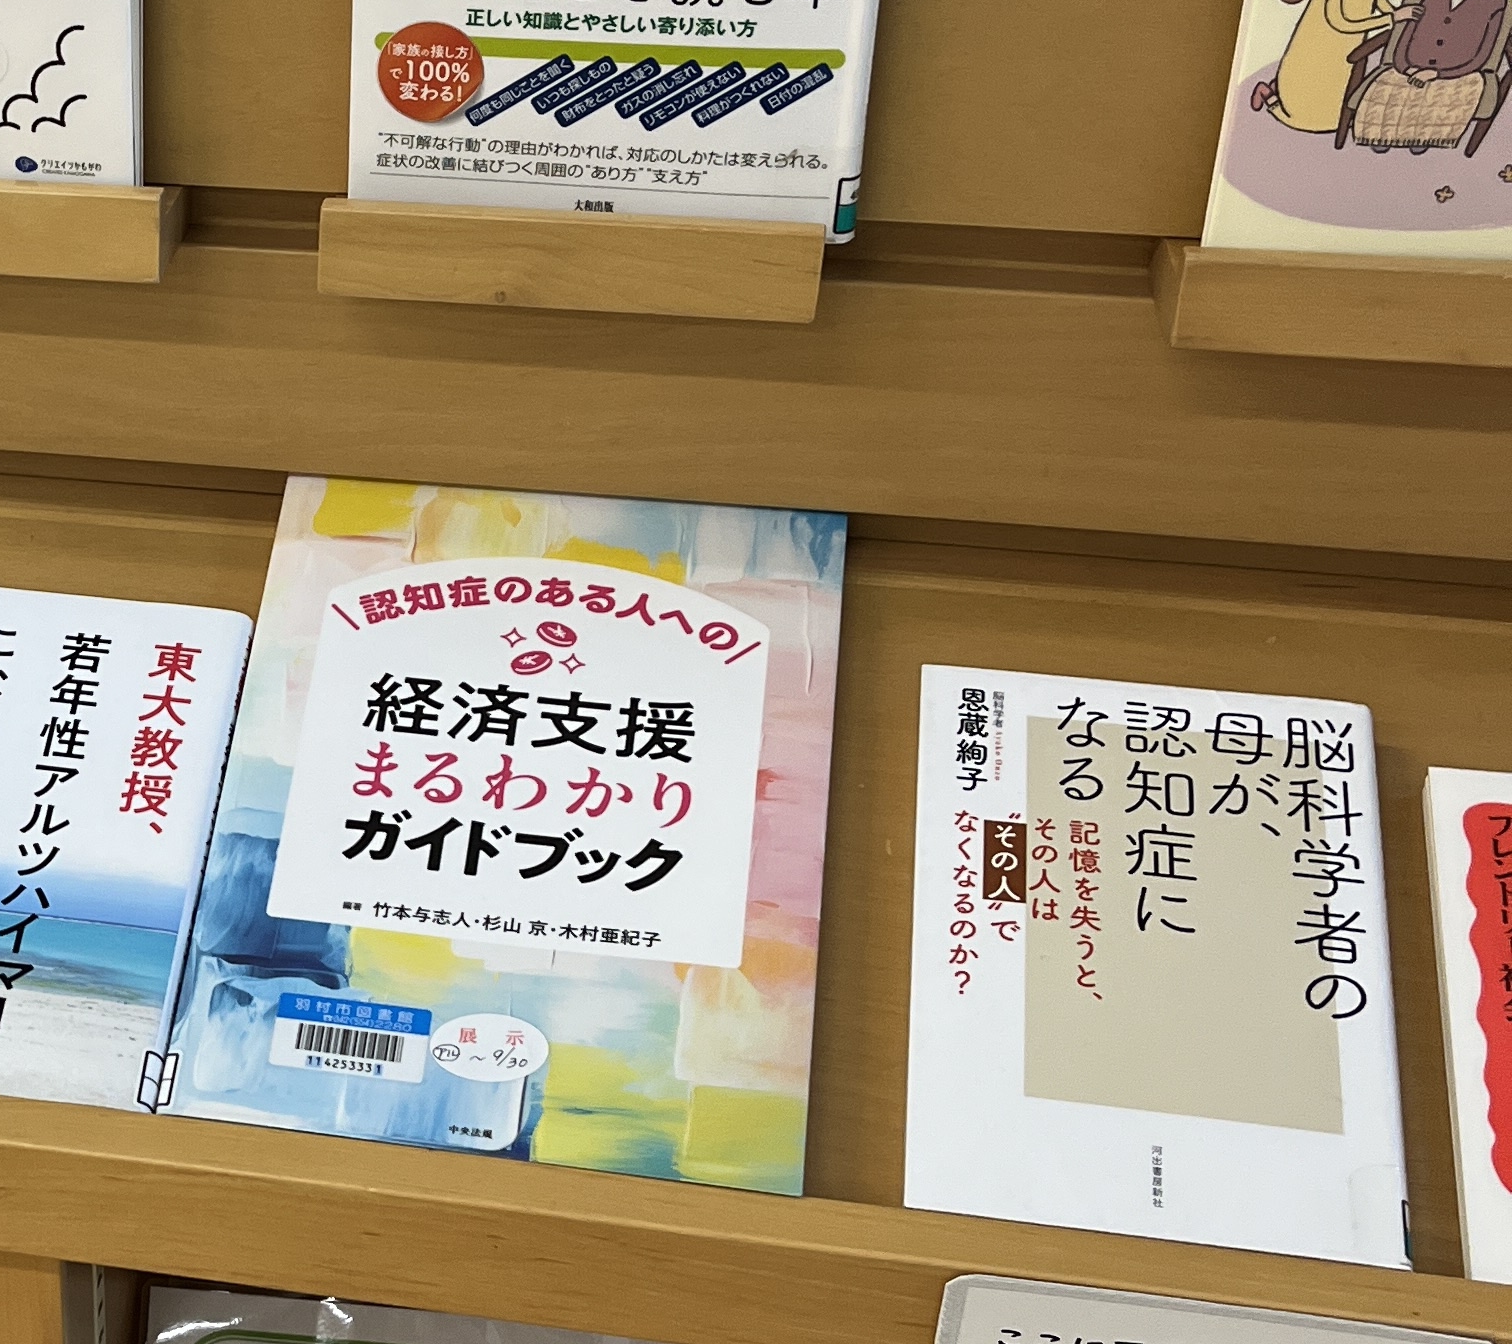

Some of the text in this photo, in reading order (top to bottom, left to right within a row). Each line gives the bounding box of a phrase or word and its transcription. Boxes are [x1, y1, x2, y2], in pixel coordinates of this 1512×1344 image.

[465, 8, 758, 38] 正しい知識とやさしい寄り添い方
[358, 574, 739, 653] 認知症のある人への
[362, 673, 696, 764] 経済支援
[1057, 696, 1110, 802] なる
[351, 741, 692, 830] まるわかり
[1123, 701, 1198, 934] 認知症に
[1205, 712, 1283, 837] 母が、
[341, 807, 685, 893] ガイドブック
[1029, 818, 1060, 923] その人は
[1283, 717, 1368, 1020] 脳科学者の
